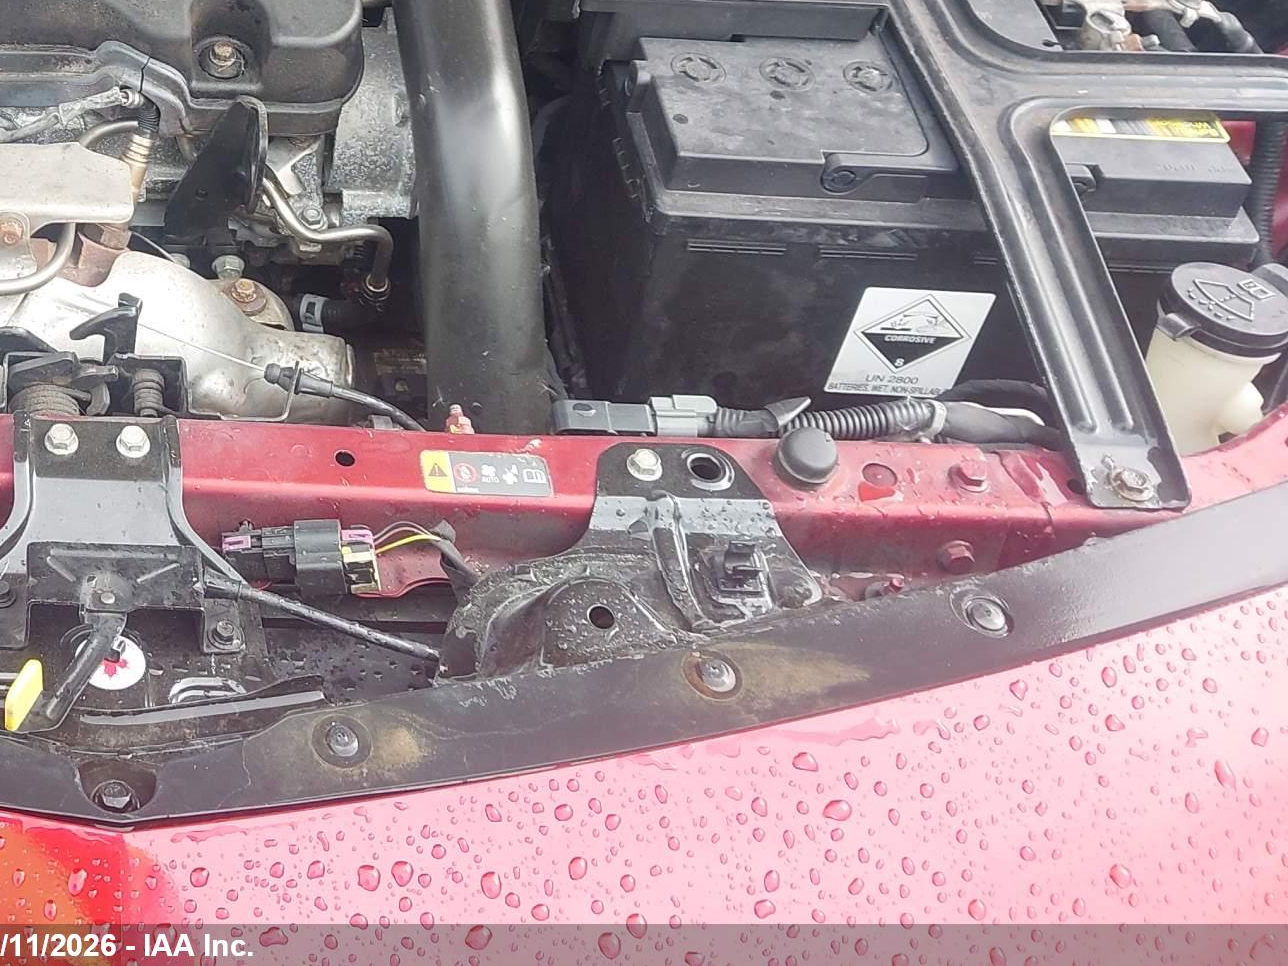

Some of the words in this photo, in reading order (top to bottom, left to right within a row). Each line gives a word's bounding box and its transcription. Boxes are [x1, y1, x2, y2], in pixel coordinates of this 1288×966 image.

[884, 334, 937, 345] CORROSIVE
[893, 357, 905, 367] 8
[865, 374, 886, 383] UN
[887, 375, 919, 385] 2800
